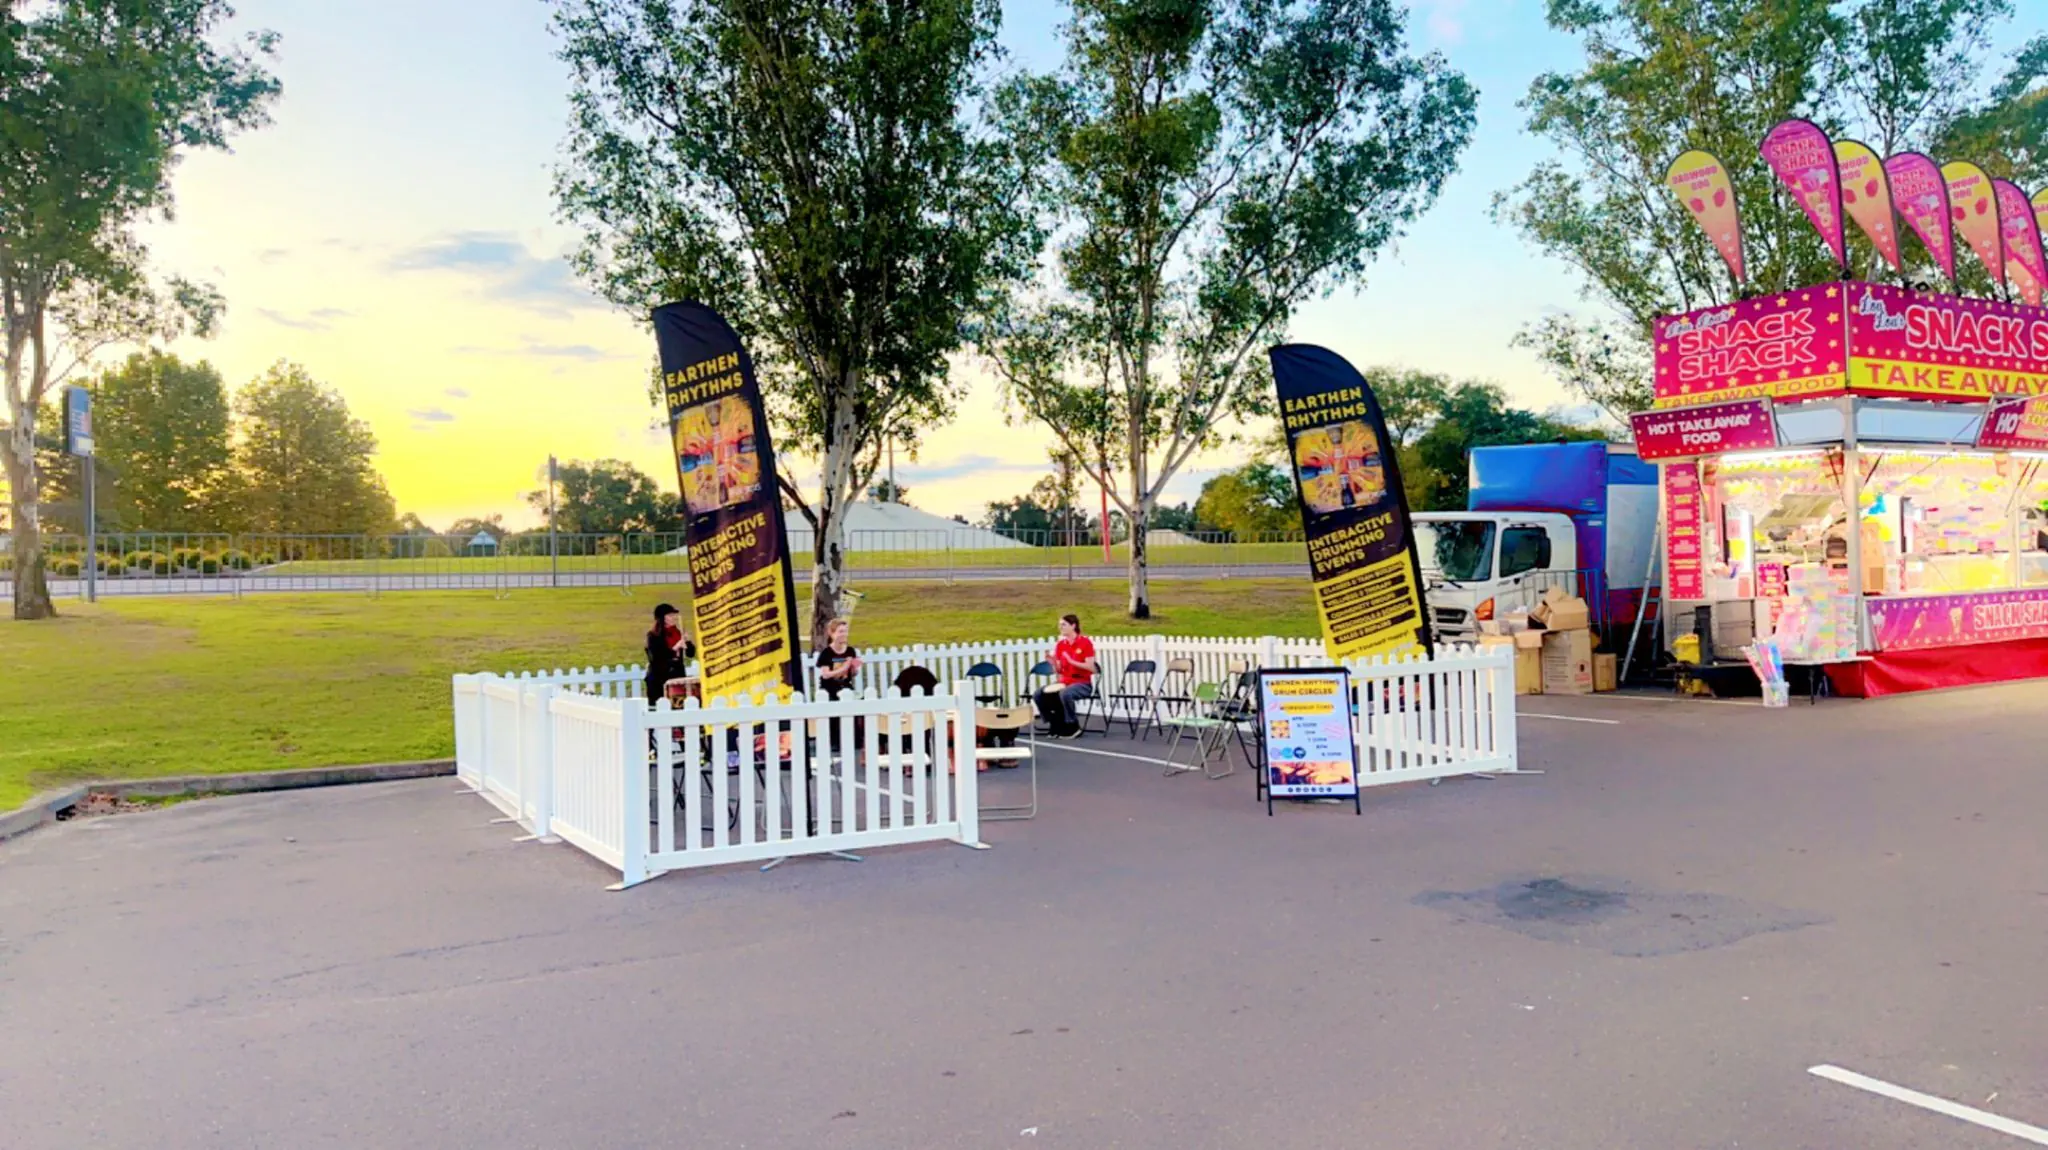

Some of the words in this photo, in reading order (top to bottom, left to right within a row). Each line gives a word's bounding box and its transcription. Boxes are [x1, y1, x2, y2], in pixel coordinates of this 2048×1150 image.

[1771, 137, 1819, 158] SNACK
[1781, 151, 1828, 171] SHACK
[1679, 308, 1815, 355] SNACK
[1906, 305, 2028, 359] SNACK
[666, 352, 740, 388] EARTHEN
[1679, 336, 1816, 381] SHACK
[668, 372, 744, 408] RHYTHMS
[1661, 385, 1769, 408] TAKEAWAY
[1774, 376, 1838, 397] FOOD
[1865, 362, 2048, 396] TAKEAWAY
[1285, 386, 1363, 413] EARTHEN
[1287, 401, 1367, 430] RHYTHMS
[1647, 422, 1675, 436] HOT
[1677, 413, 1753, 432] TAKEAWAY
[1682, 432, 1722, 446] FOOD
[1308, 512, 1393, 551] INTERACTIVE
[1312, 529, 1385, 563] DRUMMING
[1315, 548, 1366, 574] EVENTS
[1973, 602, 2023, 632] SNACK
[703, 627, 737, 646] COMMTY
